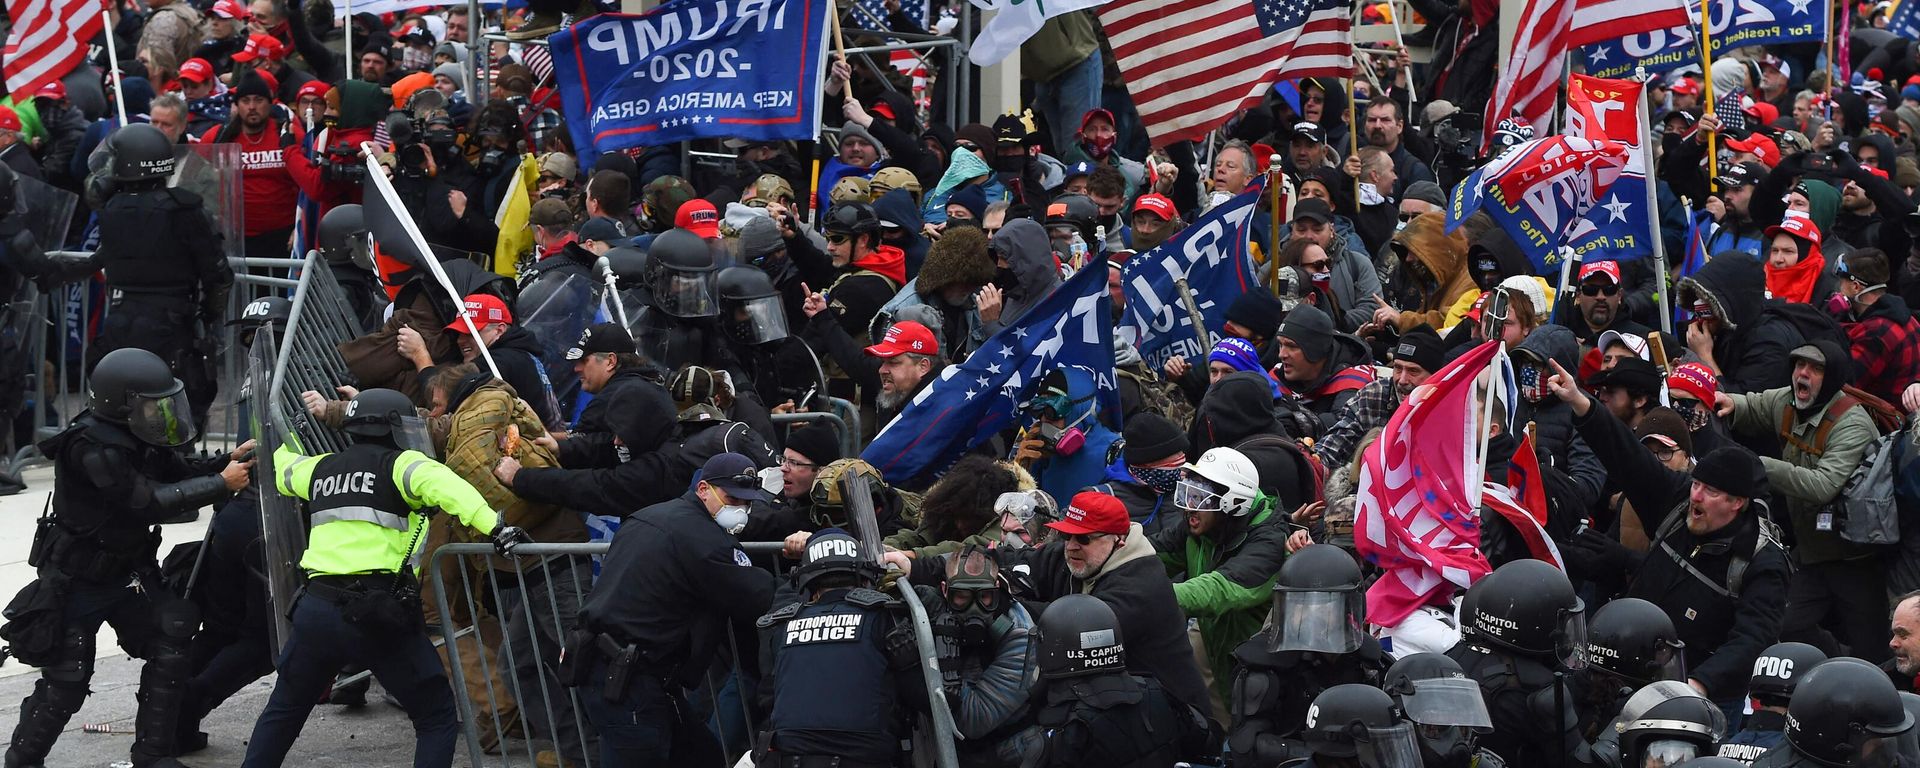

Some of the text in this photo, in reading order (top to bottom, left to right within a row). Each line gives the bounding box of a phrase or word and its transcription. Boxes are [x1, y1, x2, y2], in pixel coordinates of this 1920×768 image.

[1499, 118, 1534, 138] RUM
[241, 150, 284, 164] RUMP
[464, 301, 483, 309] MERICA
[911, 340, 923, 350] 45
[1670, 372, 1703, 388] 2020
[1673, 364, 1716, 384] RUMP
[313, 471, 377, 500] POLICE
[808, 539, 857, 563] MPDC
[786, 614, 862, 633] METROPOLITAN
[1475, 618, 1502, 636] POLICE
[1480, 611, 1519, 630] CAPITOL
[786, 626, 856, 645] POLICE
[1066, 643, 1124, 659] U.S. CAPITOL
[1587, 642, 1620, 659] APITOL
[1084, 655, 1119, 668] POLICE
[1590, 655, 1604, 665] ICE
